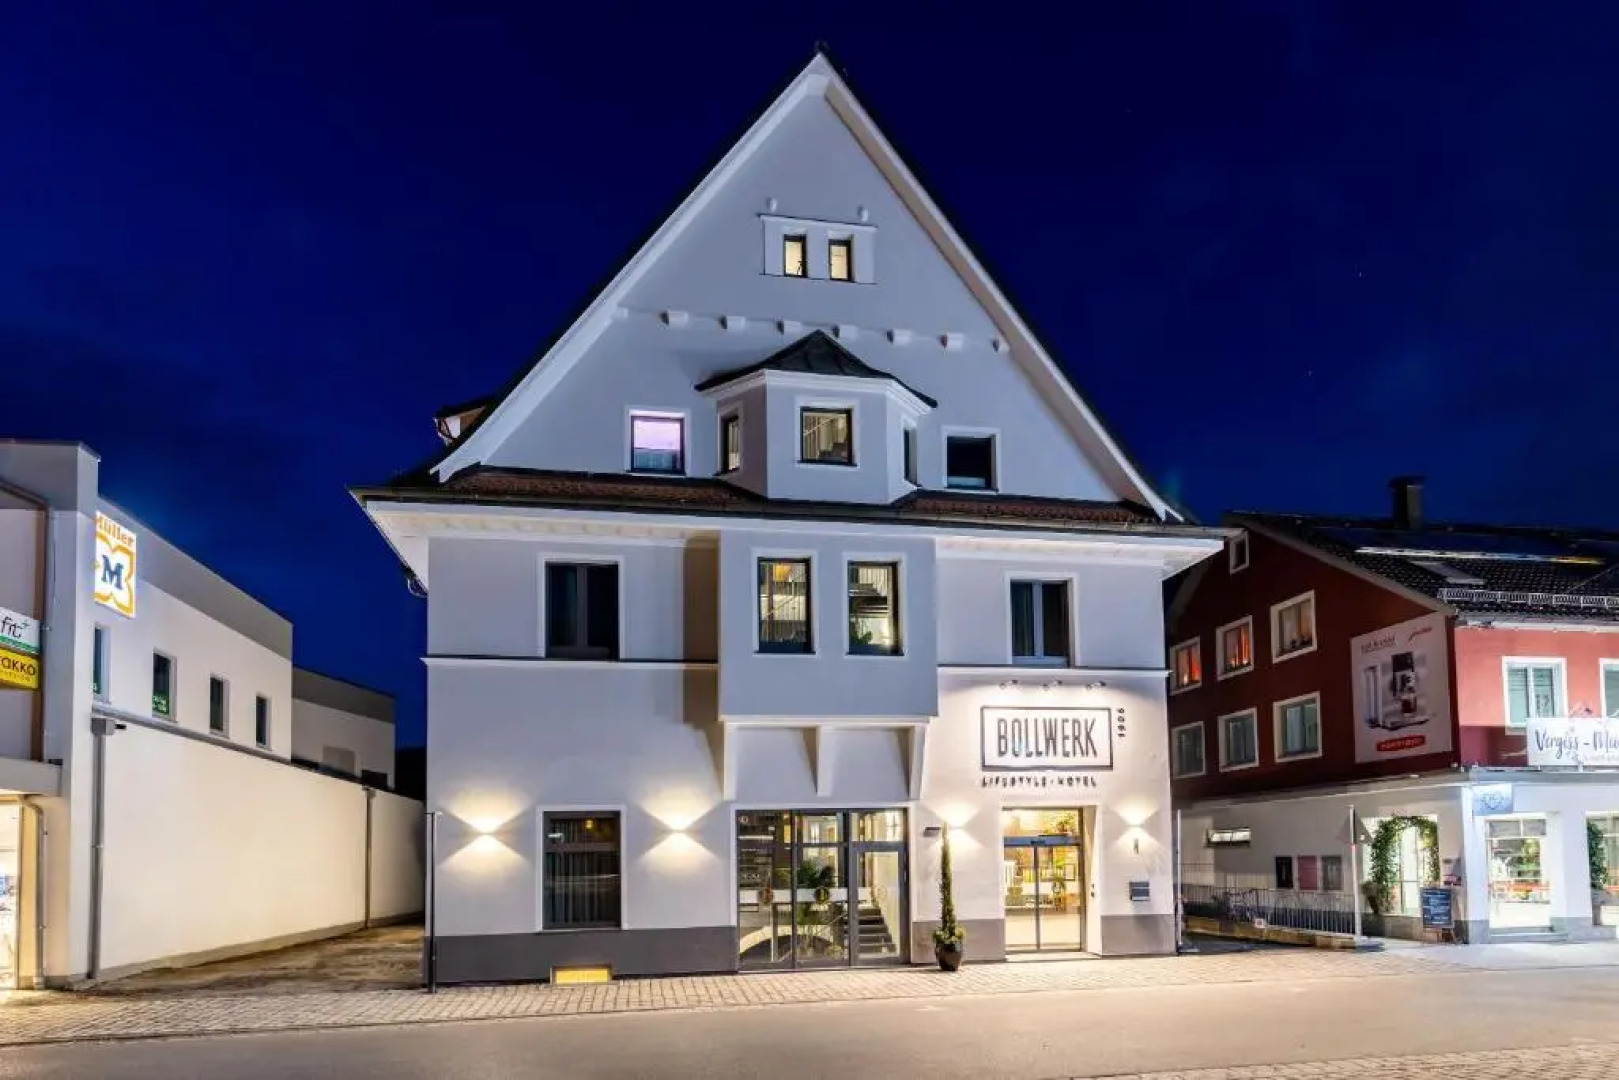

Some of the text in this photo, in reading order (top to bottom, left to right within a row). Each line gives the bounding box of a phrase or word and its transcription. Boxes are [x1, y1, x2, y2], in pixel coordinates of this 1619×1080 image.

[101, 554, 123, 590] M
[0, 656, 36, 676] AKKO
[997, 717, 1098, 758] BOLLWERK
[982, 776, 1097, 788] LIFESTYLE HOTEL
